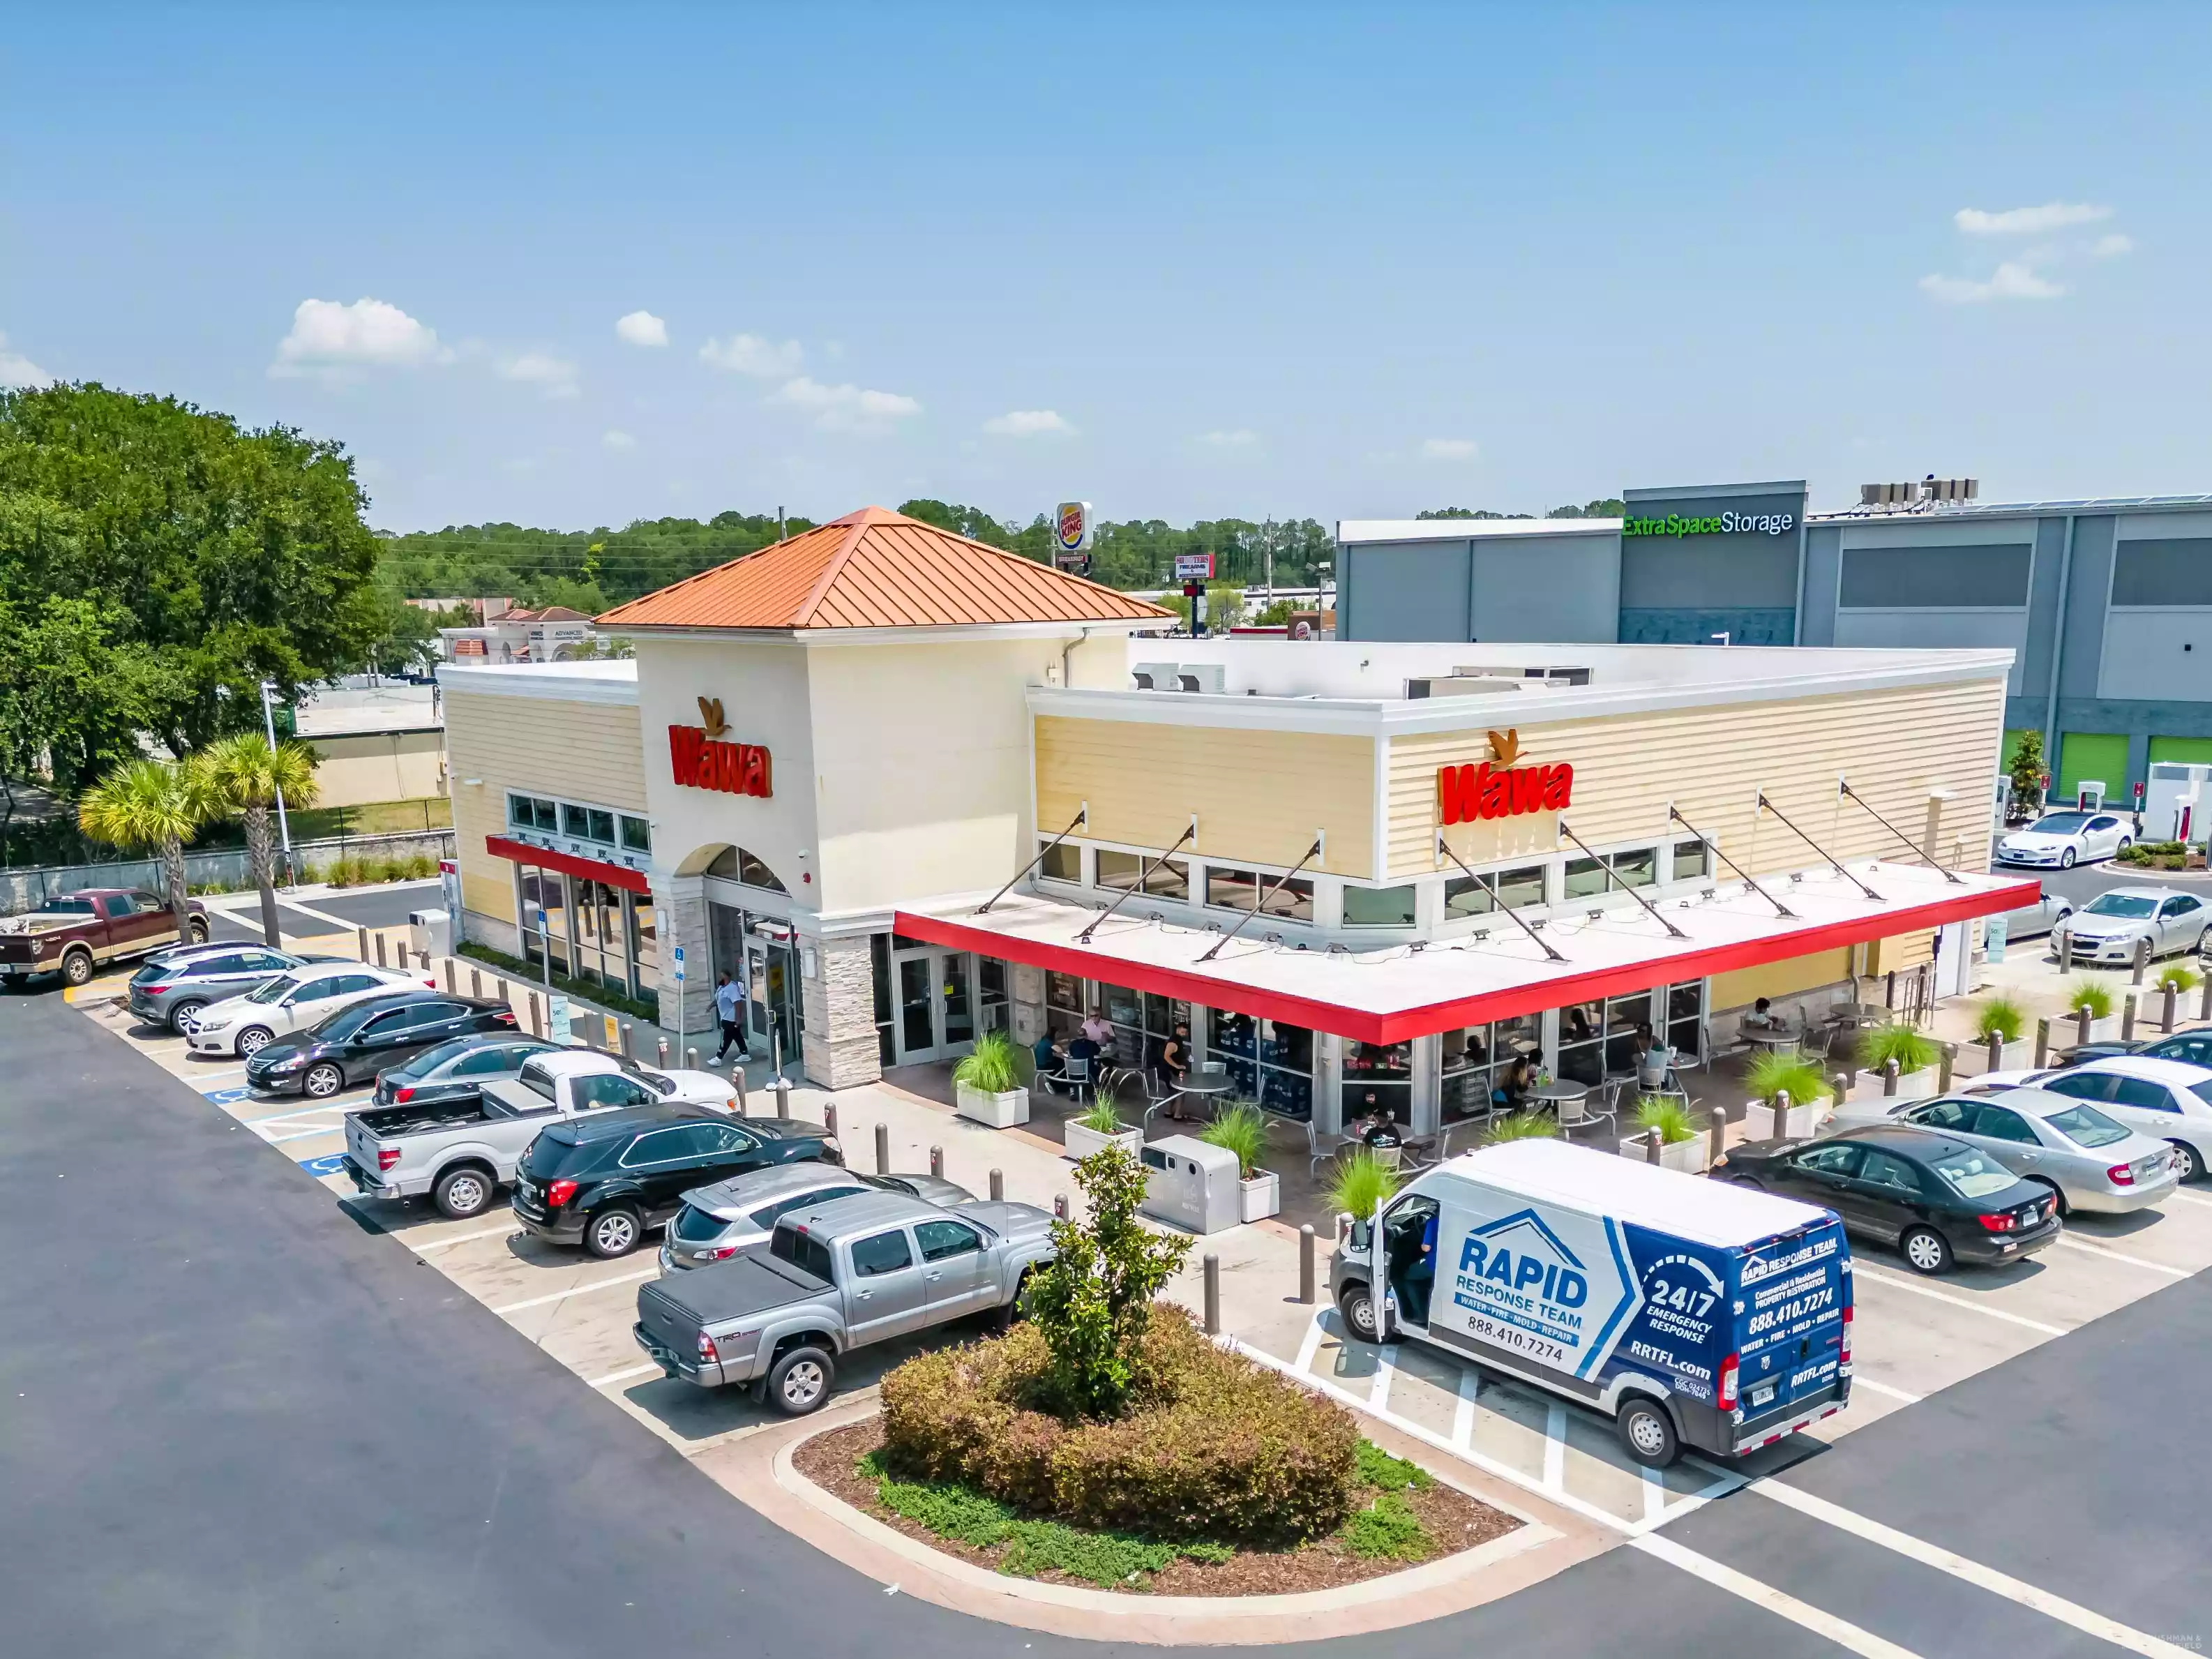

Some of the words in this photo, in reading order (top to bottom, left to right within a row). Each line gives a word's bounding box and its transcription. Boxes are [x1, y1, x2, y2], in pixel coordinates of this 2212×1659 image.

[1061, 519, 1082, 540] KING
[668, 724, 773, 798] Wawa
[1438, 762, 1574, 825] Wawa
[1459, 1237, 1588, 1308] RAPID
[1740, 1263, 1768, 1282] RAPID
[1769, 1246, 1812, 1273] RESPONSE
[1755, 1280, 1789, 1300] Commercial
[1796, 1267, 1826, 1285] Residential
[1457, 1275, 1534, 1312] RESPONSE
[1539, 1303, 1582, 1330] TEAM
[1651, 1279, 1715, 1318] 24/7
[1749, 1287, 1833, 1335] 888.410.7274
[1755, 1291, 1786, 1309] PROPERTY
[1787, 1276, 1826, 1298] RESTORATION
[1461, 1296, 1487, 1312] WATER
[1491, 1306, 1509, 1321] FIRE
[1513, 1314, 1537, 1330] MOLD
[1542, 1326, 1573, 1344] REPAIR
[1468, 1316, 1563, 1363] 888.410.7274
[1647, 1305, 1713, 1334] EMERGENCY
[1649, 1318, 1706, 1344] RESPONSE
[1740, 1339, 1764, 1355] WATER
[1770, 1330, 1786, 1343] FIRE
[1793, 1319, 1811, 1335] MOLD
[1817, 1307, 1839, 1324] REPAIR
[1630, 1340, 1711, 1381] RRTFL.com
[1791, 1360, 1837, 1388] RRTFL.com
